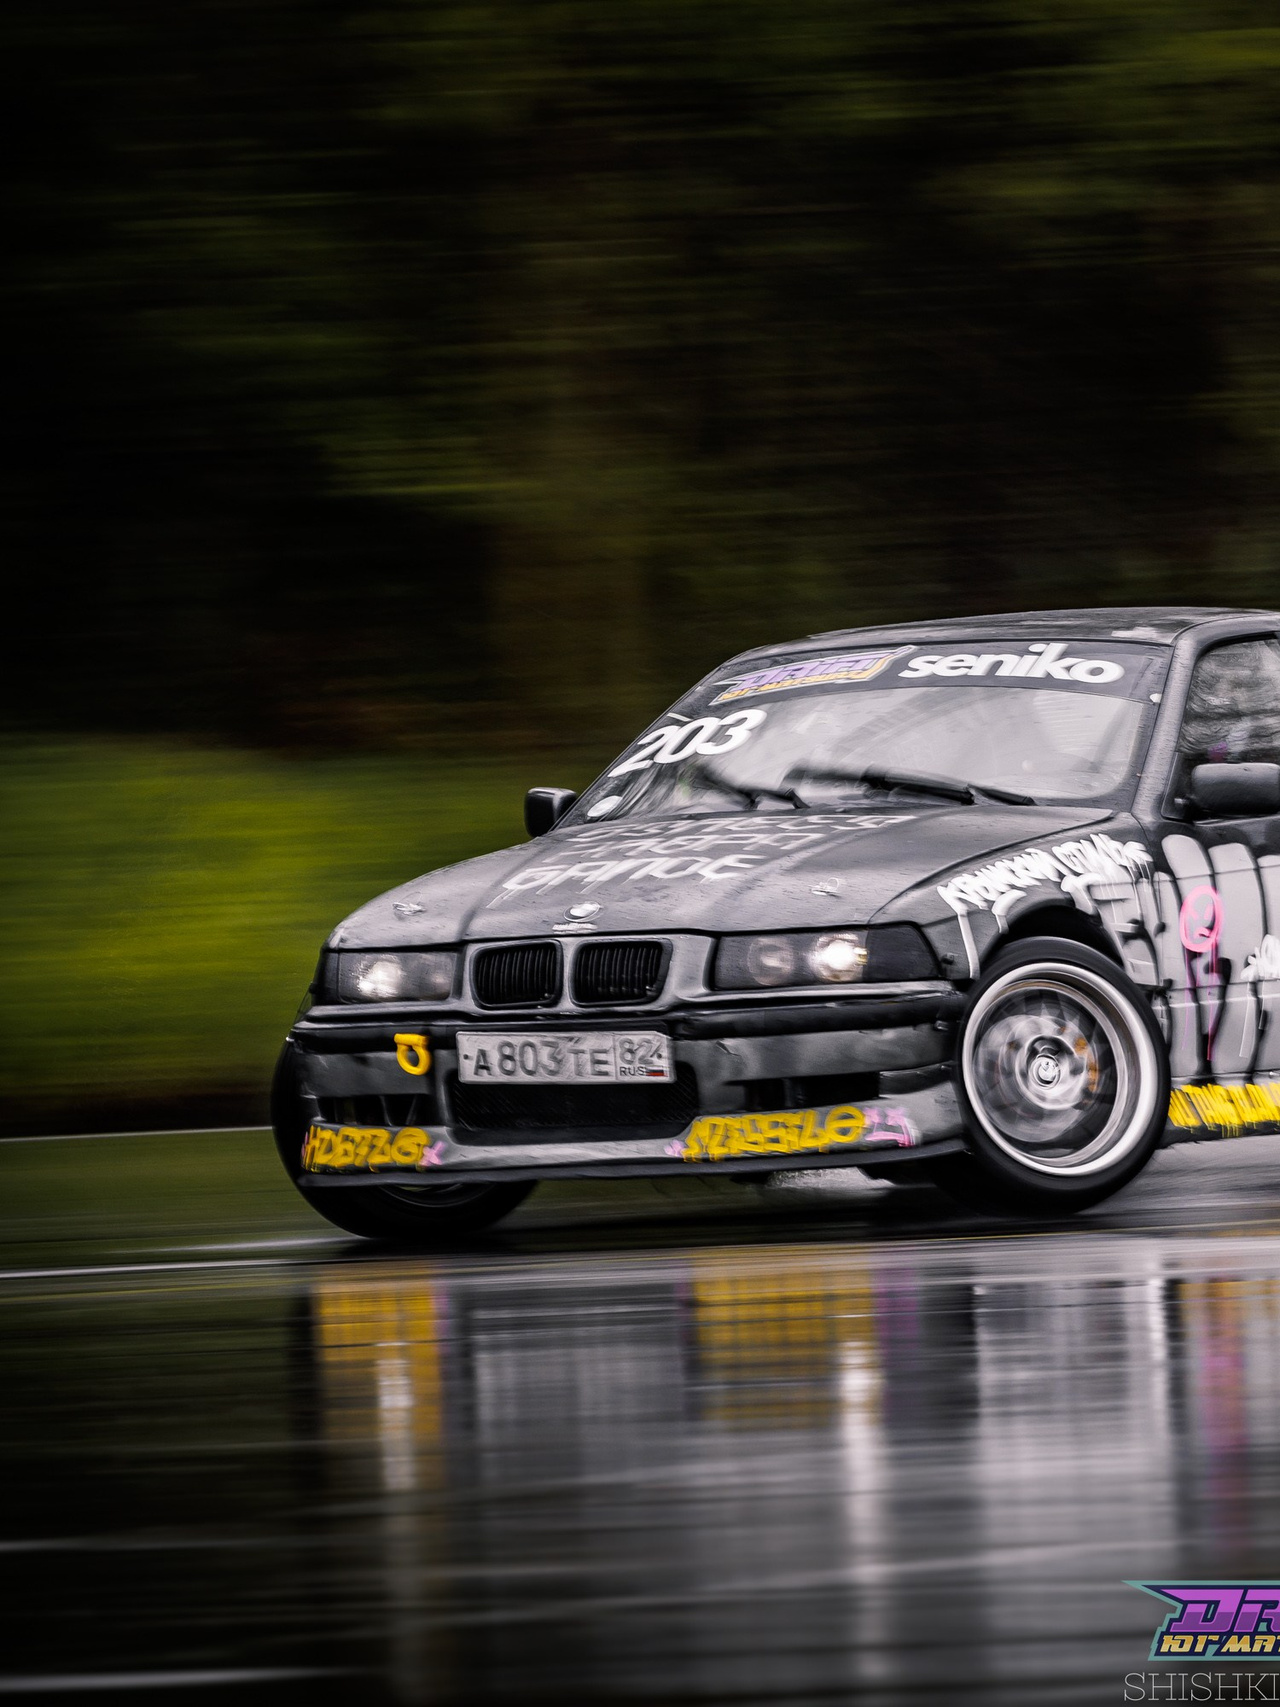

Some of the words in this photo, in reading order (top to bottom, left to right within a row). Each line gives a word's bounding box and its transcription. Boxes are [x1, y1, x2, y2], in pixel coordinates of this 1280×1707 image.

[898, 642, 1125, 684] seniko
[607, 709, 767, 777] 203
[619, 1066, 646, 1077] RUS
